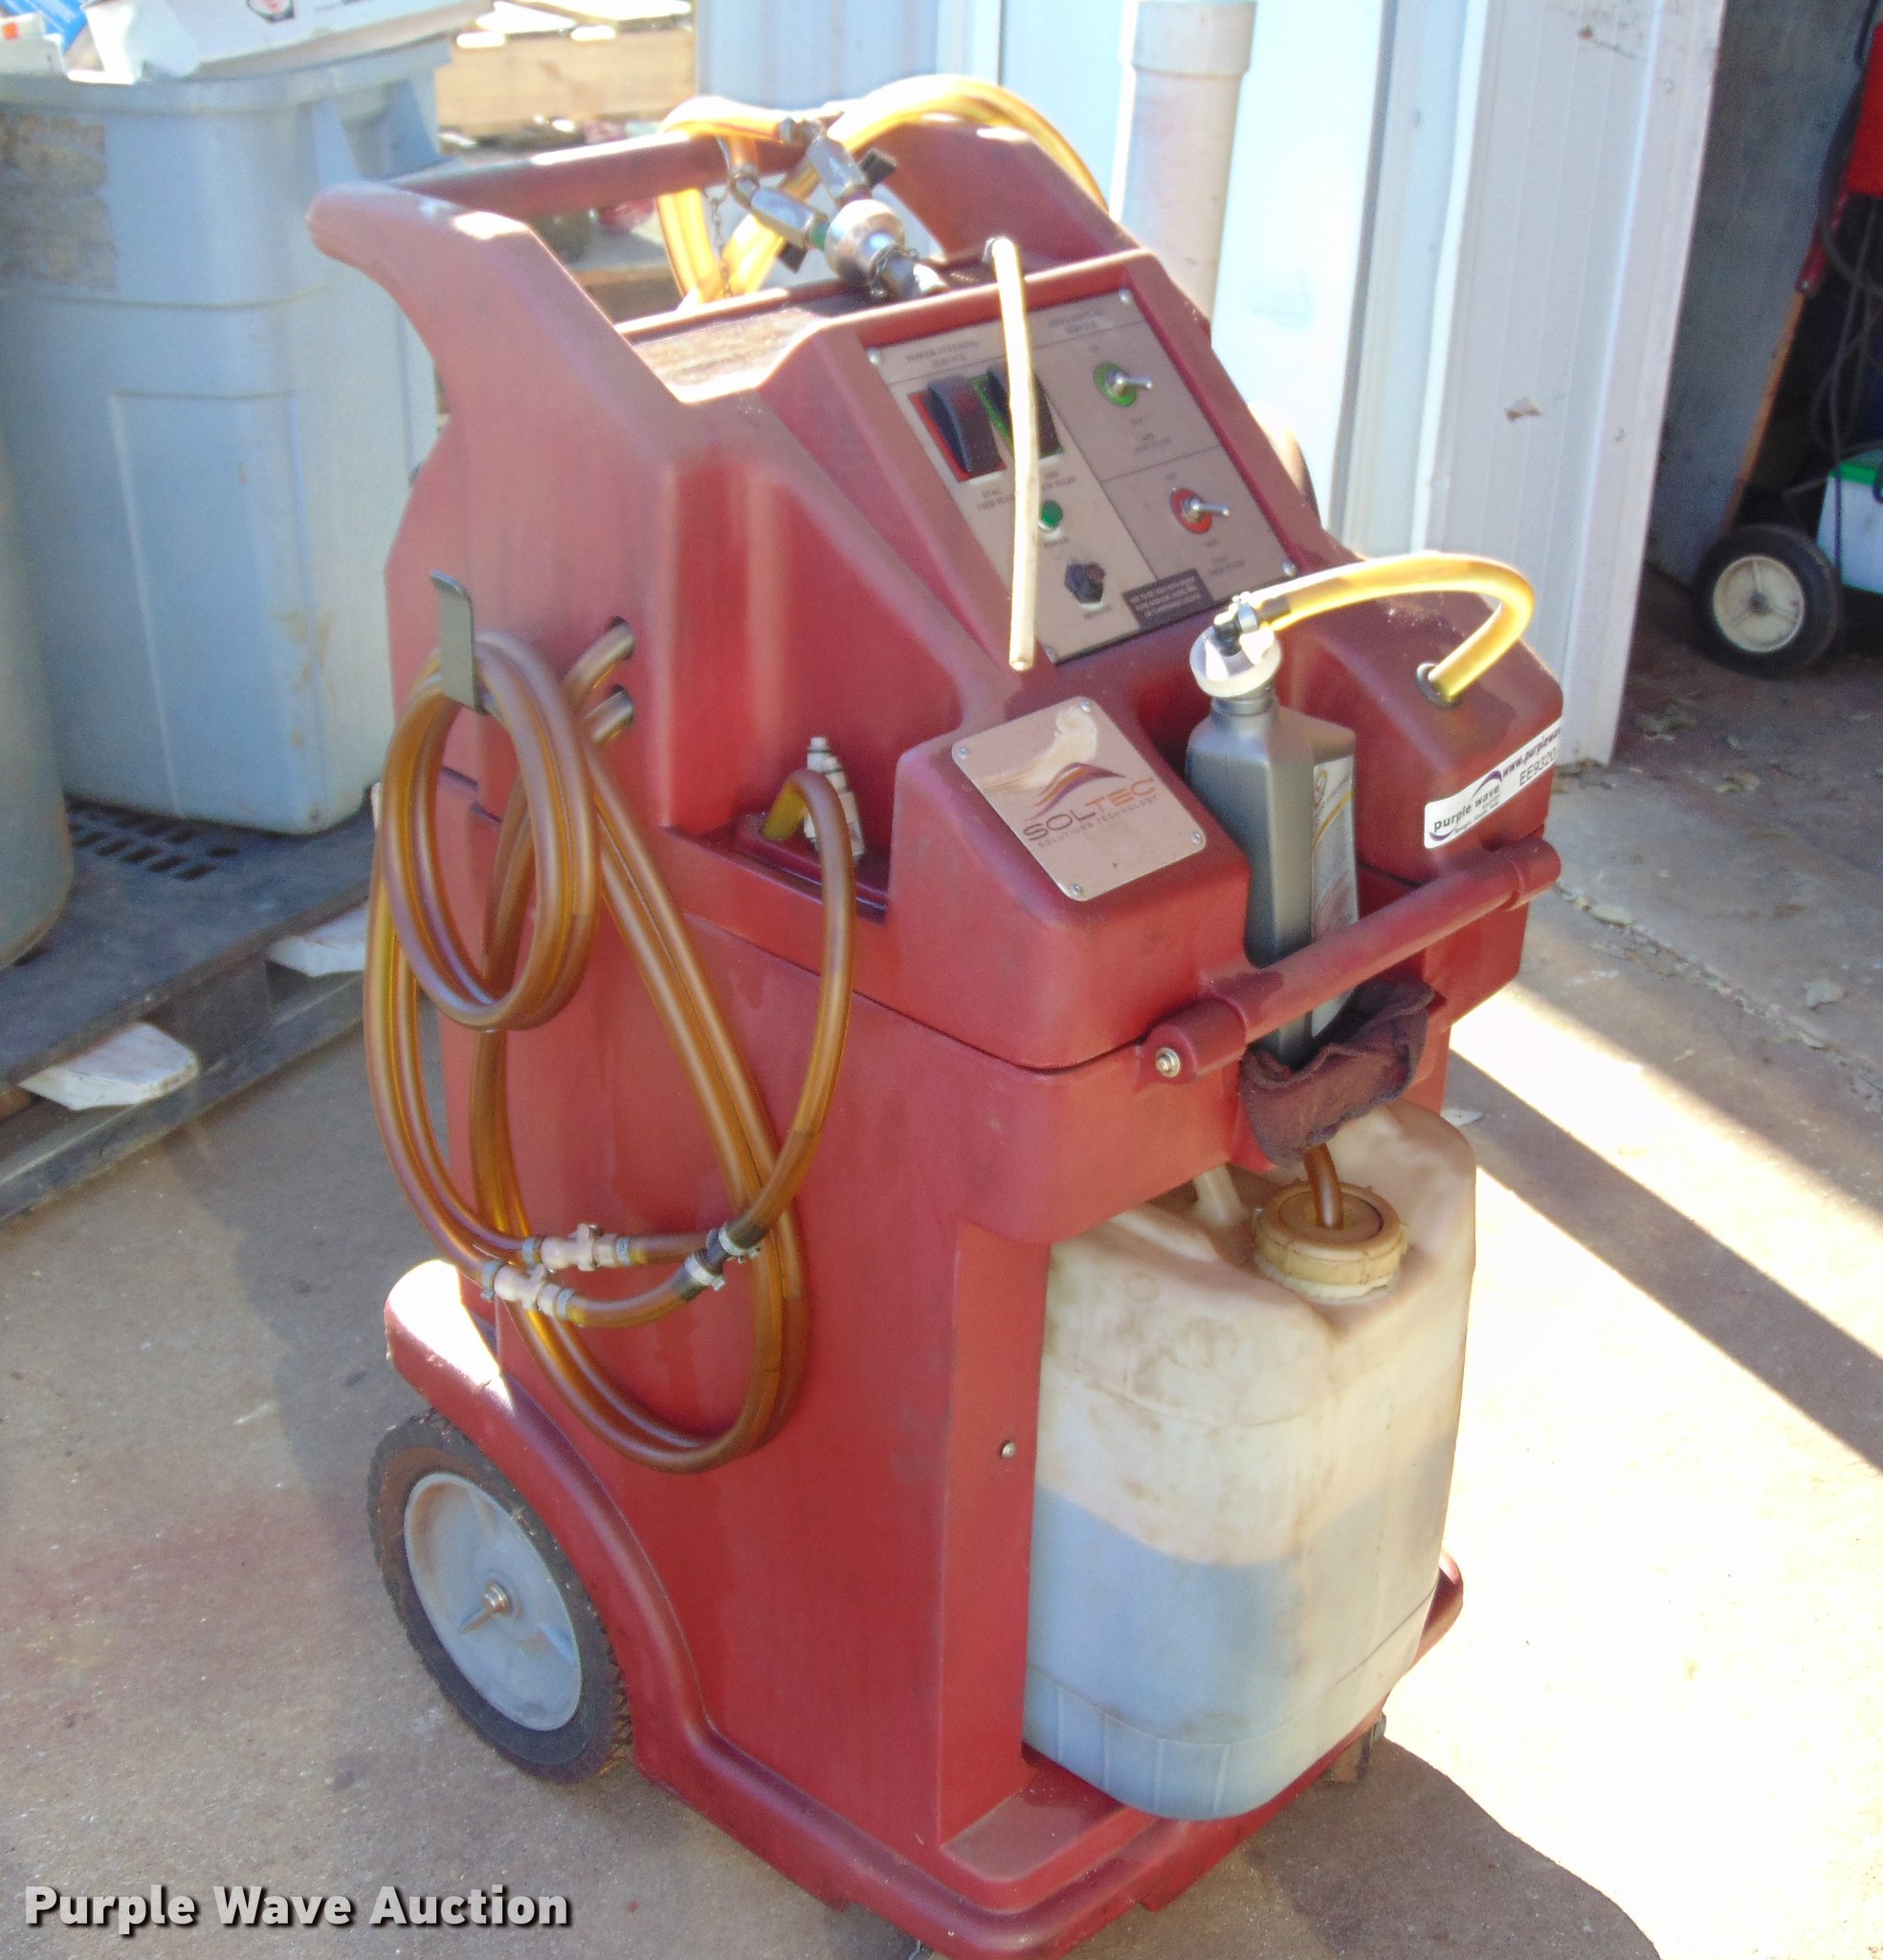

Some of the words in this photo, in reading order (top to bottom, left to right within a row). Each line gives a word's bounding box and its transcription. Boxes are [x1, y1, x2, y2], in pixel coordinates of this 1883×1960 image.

[1023, 779, 1155, 841] SOLTEC
[1037, 822, 1094, 849] SOLUTIONS
[1096, 794, 1158, 824] TECHNOLOGY
[1434, 803, 1472, 834] purple
[1474, 785, 1499, 808] wave
